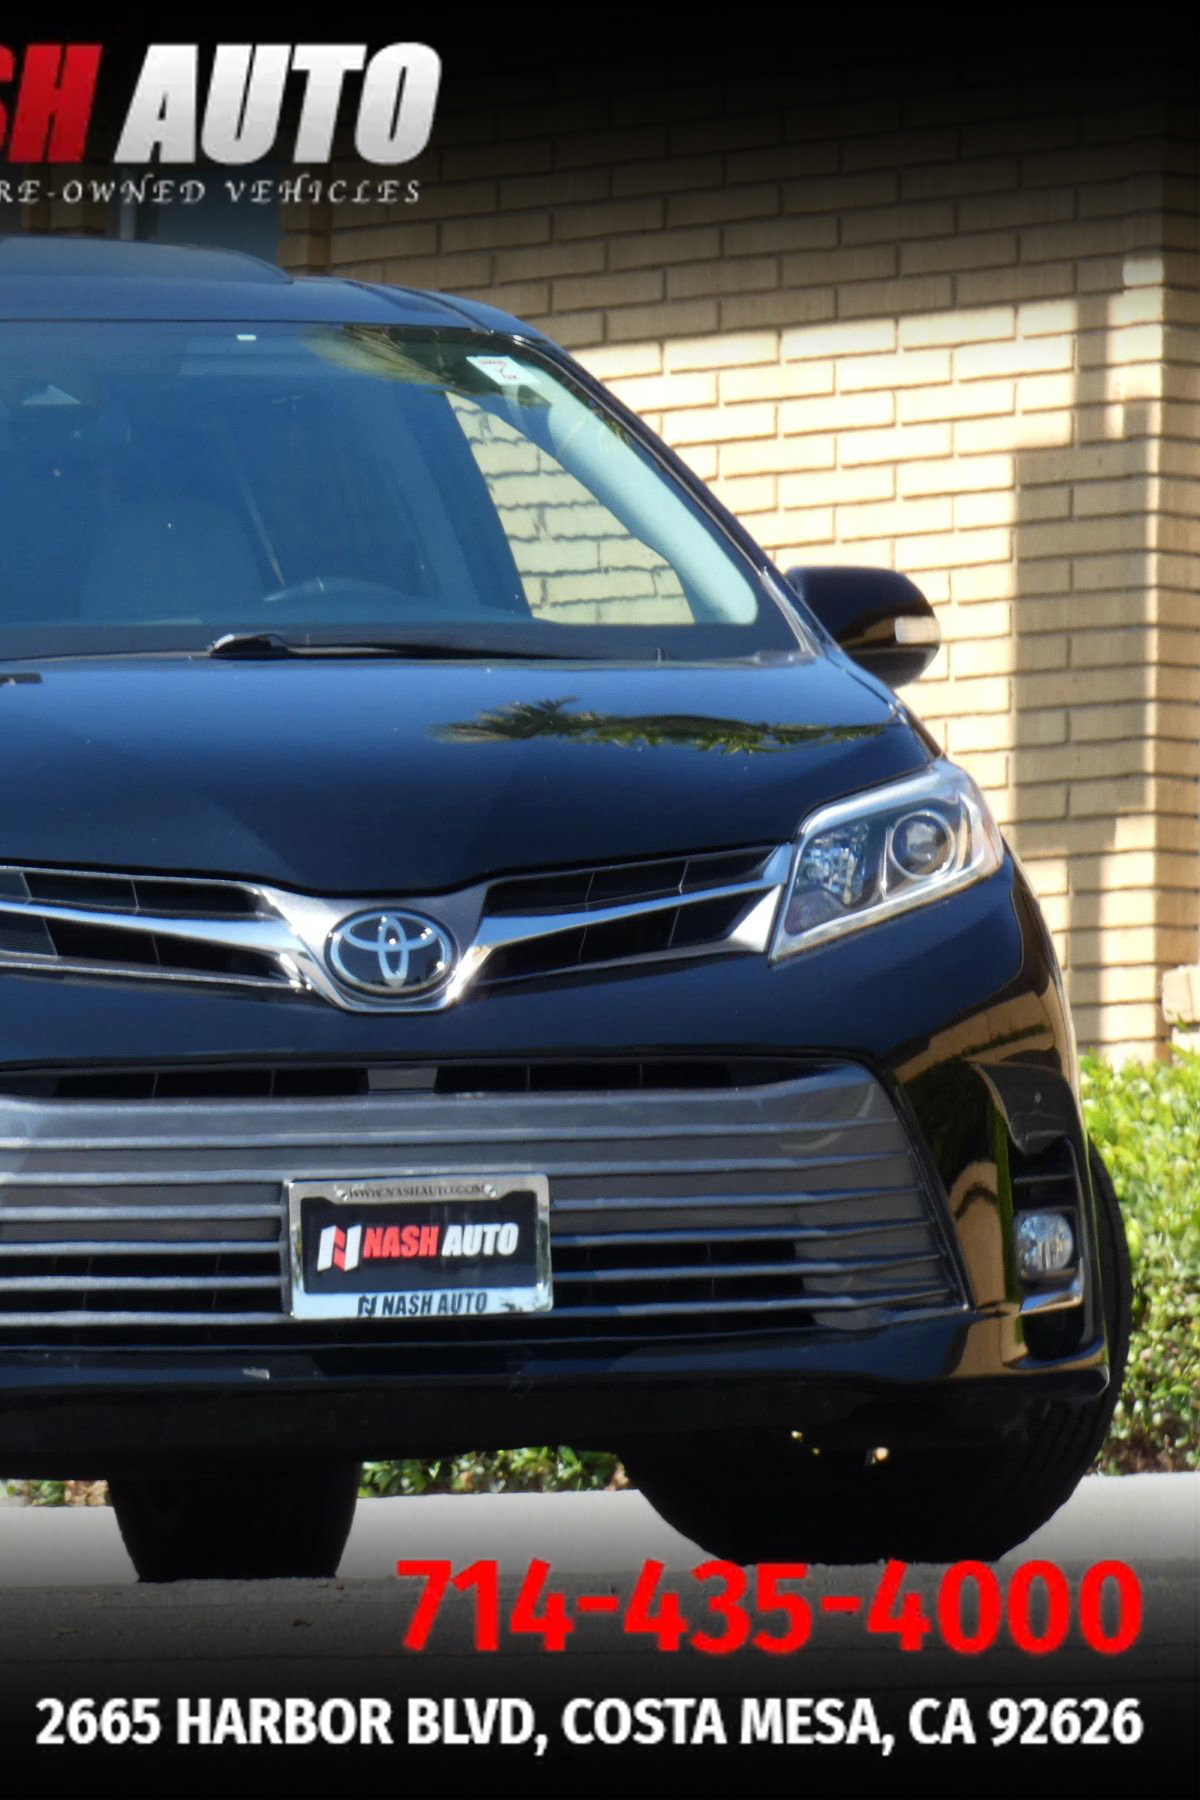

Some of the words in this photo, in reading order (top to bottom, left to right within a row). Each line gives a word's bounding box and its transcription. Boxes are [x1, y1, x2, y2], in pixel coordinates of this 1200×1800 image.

[362, 1225, 440, 1260] NASH
[441, 1222, 519, 1257] AUTO
[381, 1294, 434, 1316] NASH
[436, 1291, 488, 1314] AUTO
